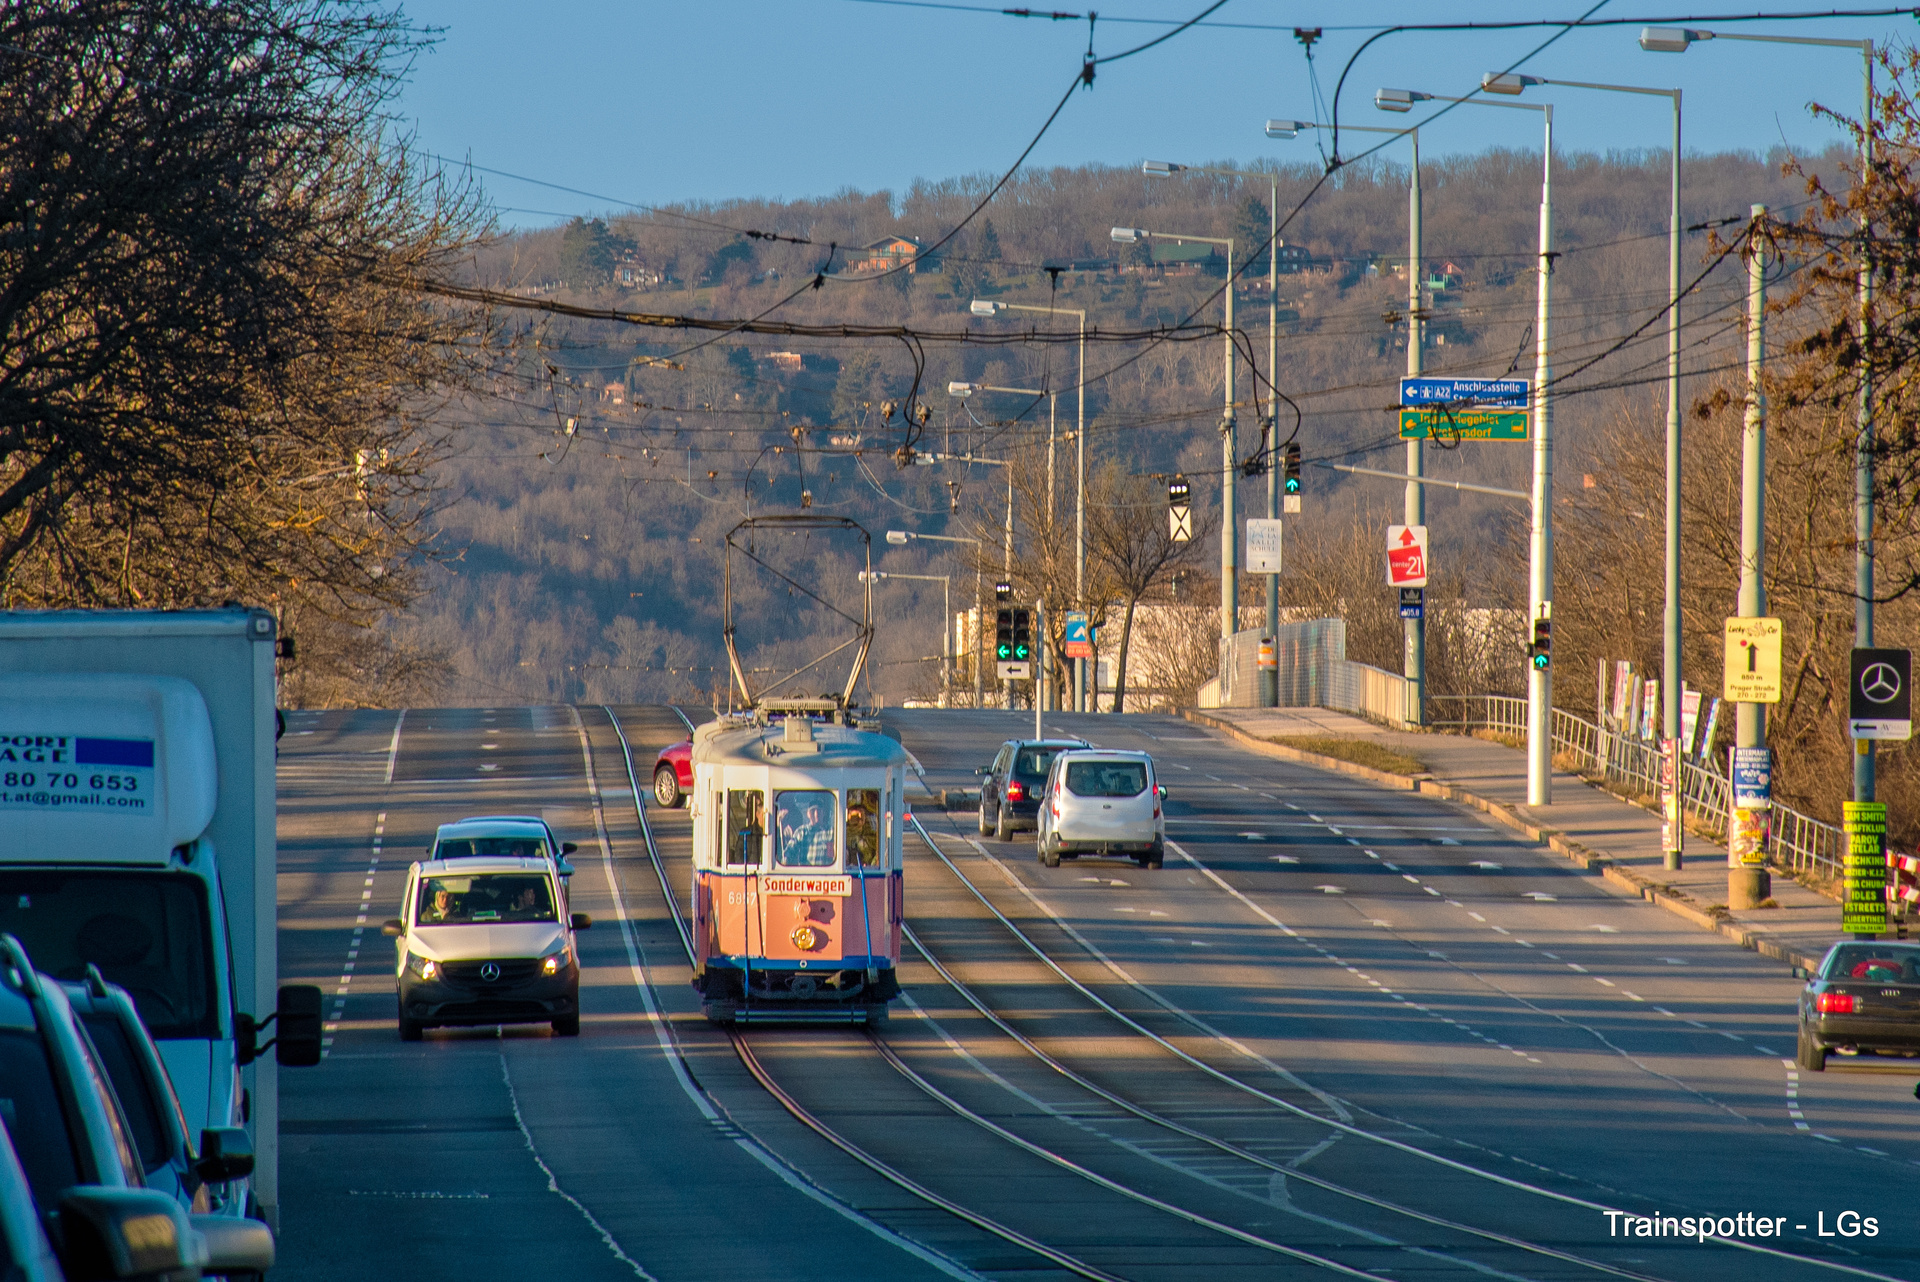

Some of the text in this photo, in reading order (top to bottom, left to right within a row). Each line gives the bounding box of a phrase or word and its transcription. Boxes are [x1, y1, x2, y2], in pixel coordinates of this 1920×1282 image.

[1435, 386, 1450, 399] A22
[1453, 381, 1521, 393] Anschlussstelle
[1406, 556, 1422, 576] 21
[1728, 625, 1745, 634] Lucky
[1730, 684, 1752, 692] Prager
[4, 772, 138, 792] 80 70 653
[1844, 811, 1885, 822] SAM SMITH
[1843, 823, 1885, 833] KRAFTKLUB
[1850, 834, 1878, 844] PAROV
[1848, 844, 1880, 854] STELAR
[1843, 855, 1885, 866] DEICHKIND
[764, 877, 845, 894] Sonderwagen
[1851, 890, 1877, 901] IDLES
